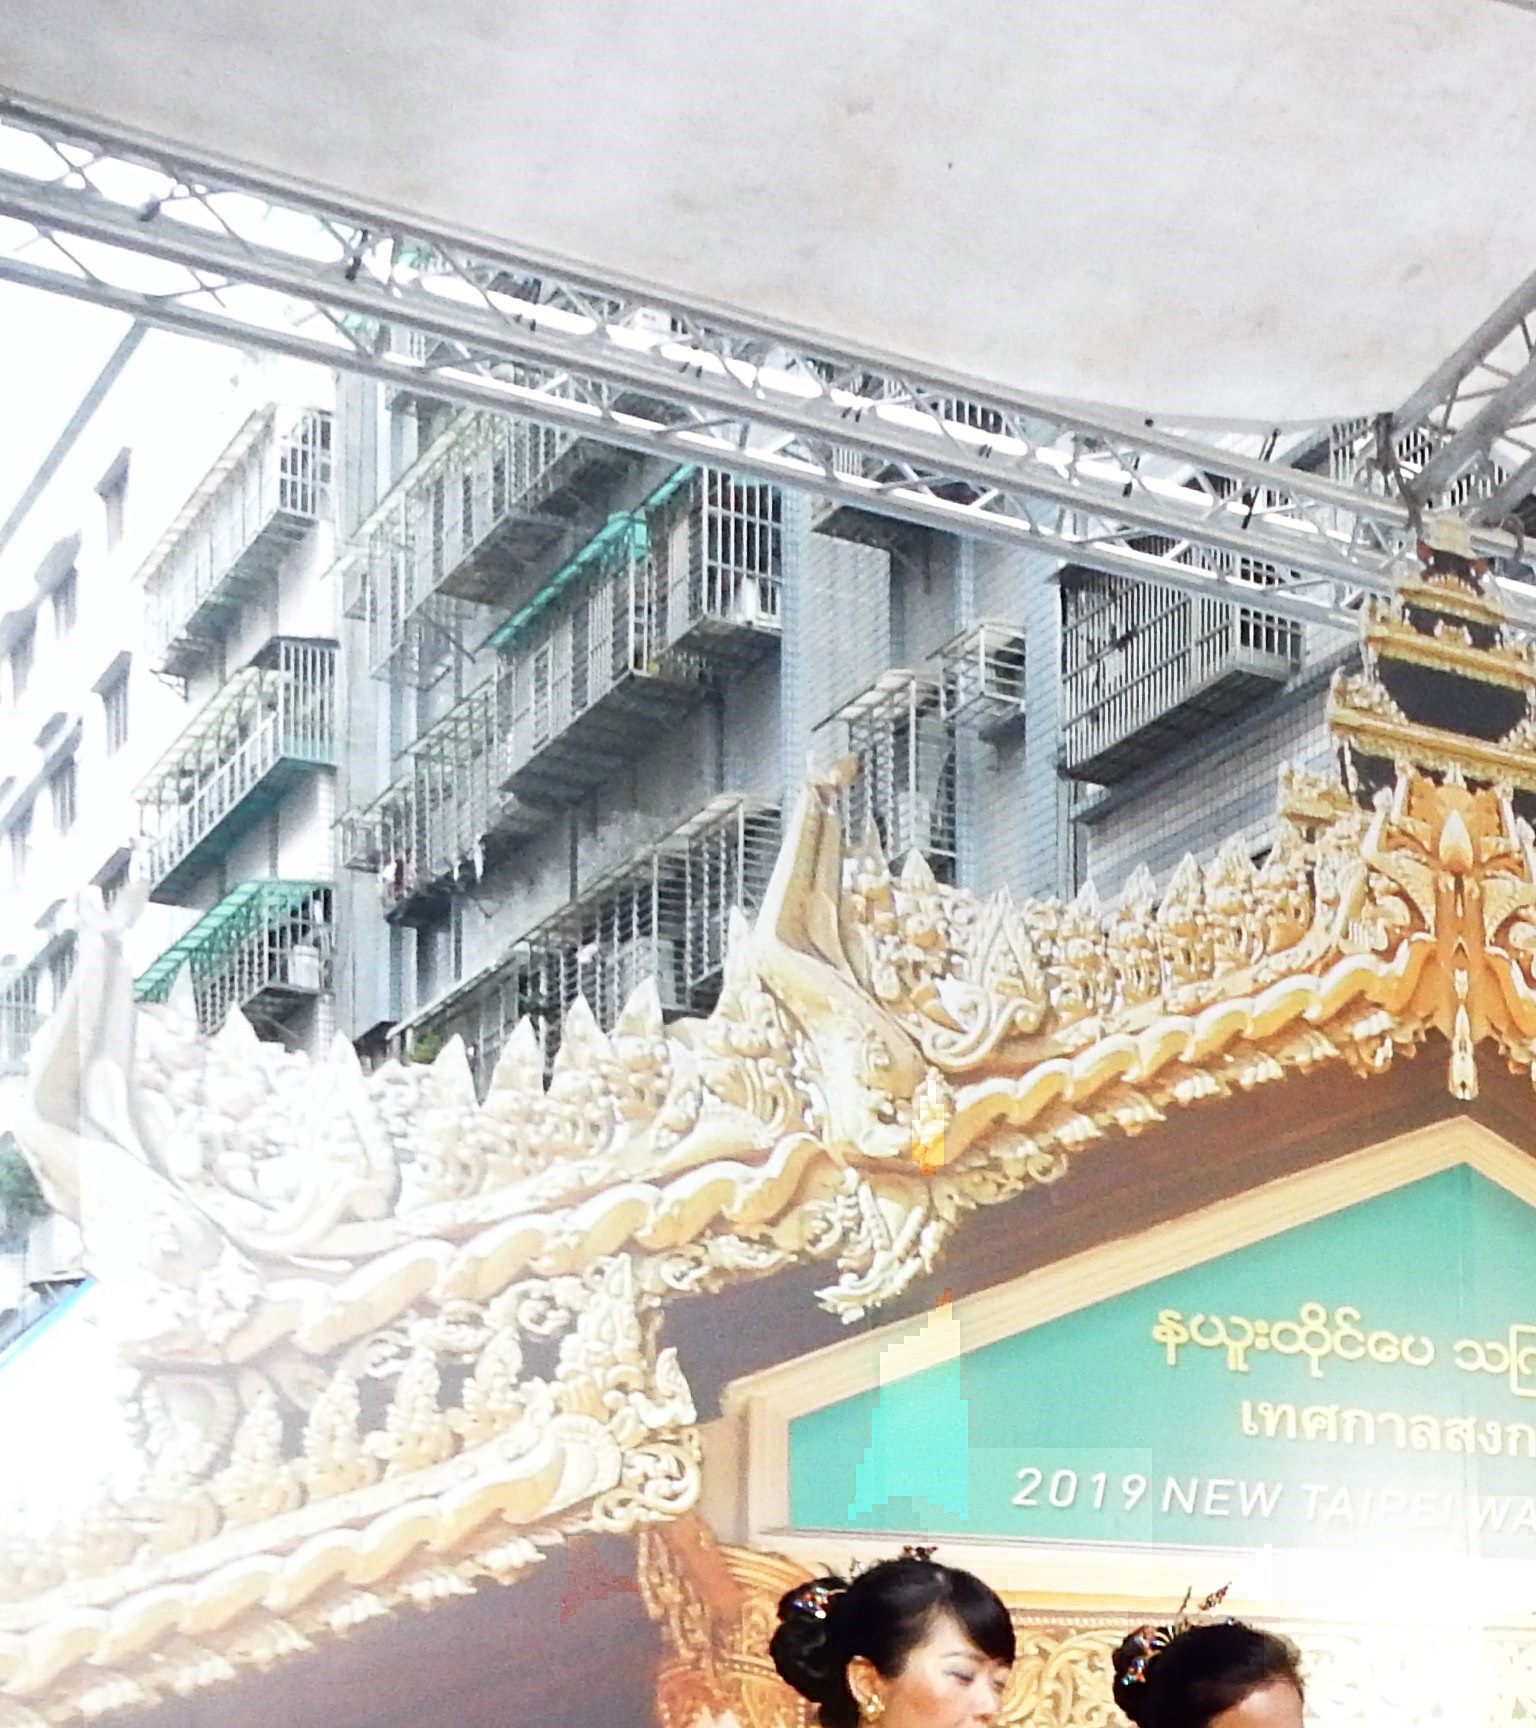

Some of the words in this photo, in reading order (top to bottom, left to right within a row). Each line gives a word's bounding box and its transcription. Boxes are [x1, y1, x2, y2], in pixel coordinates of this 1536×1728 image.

[1011, 1467, 1148, 1511] 2019
[1161, 1476, 1284, 1518] NEW
[1300, 1483, 1456, 1530] TAIPEI
